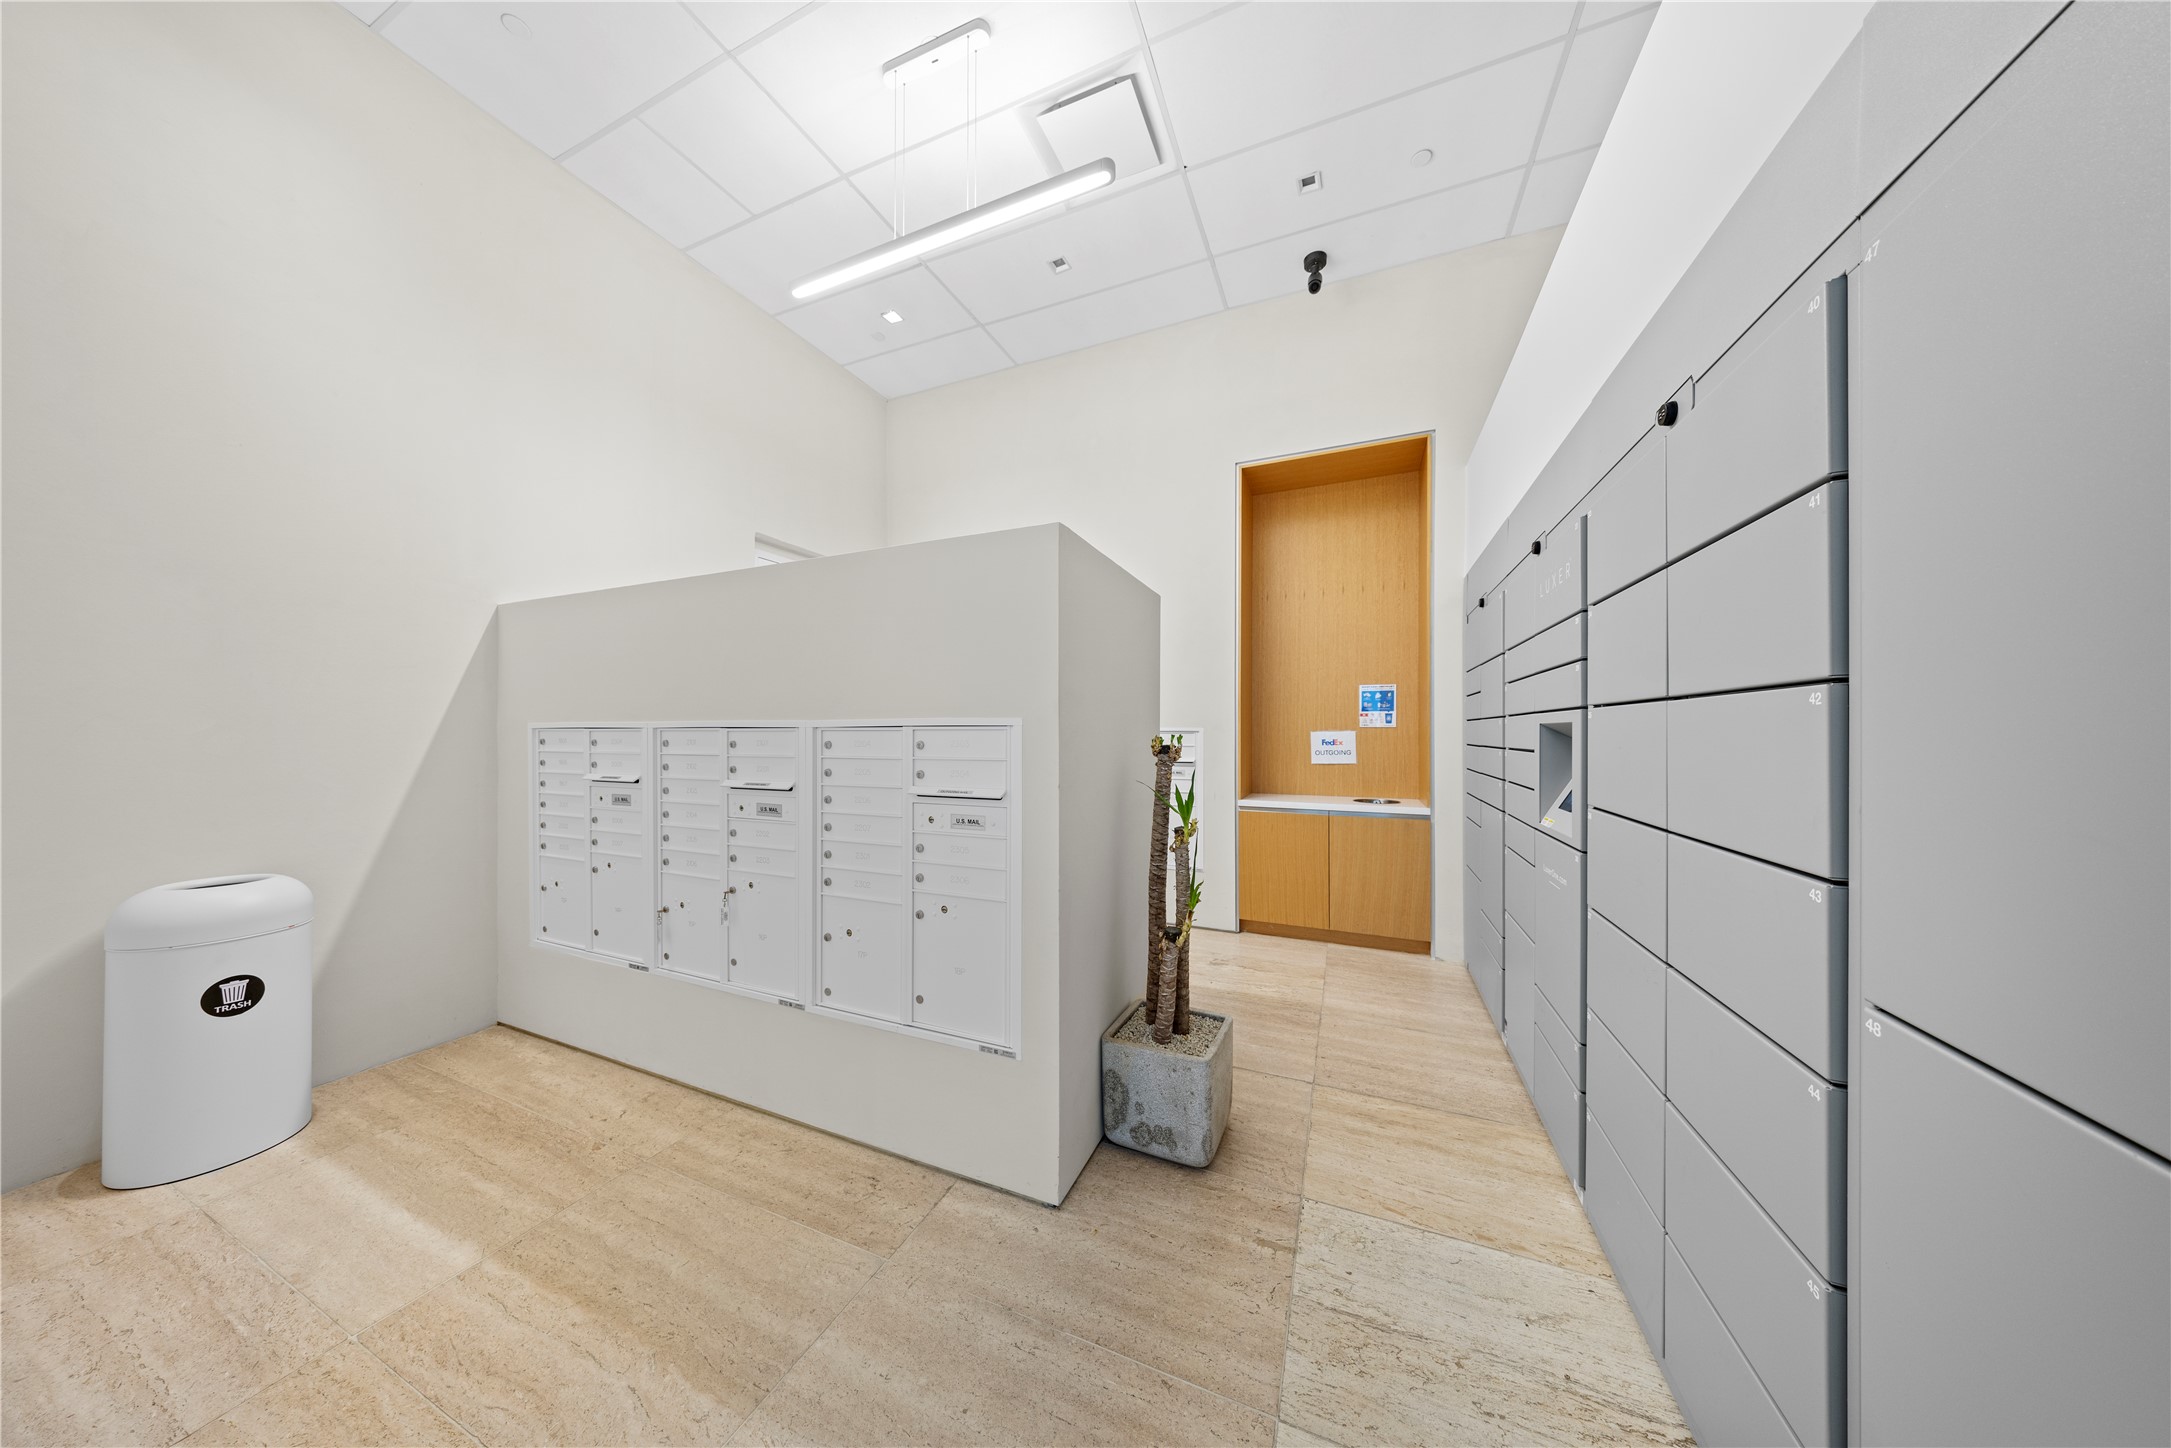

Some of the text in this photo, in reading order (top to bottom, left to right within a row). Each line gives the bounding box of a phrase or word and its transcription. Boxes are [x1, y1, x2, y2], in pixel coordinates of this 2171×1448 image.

[1864, 239, 1880, 262] 47
[1807, 295, 1820, 313] 40
[1809, 492, 1820, 508] 41
[1539, 562, 1571, 598] LUXER
[1809, 691, 1822, 705] 42
[854, 824, 872, 832] 2207
[950, 845, 970, 854] 2305
[854, 880, 871, 888] 2302
[950, 875, 970, 885] 2306
[1809, 888, 1822, 903] 43
[214, 1000, 252, 1013] TRASH
[1865, 1018, 1881, 1037] 48
[1808, 1084, 1821, 1101] 44
[1806, 1280, 1820, 1300] 45
